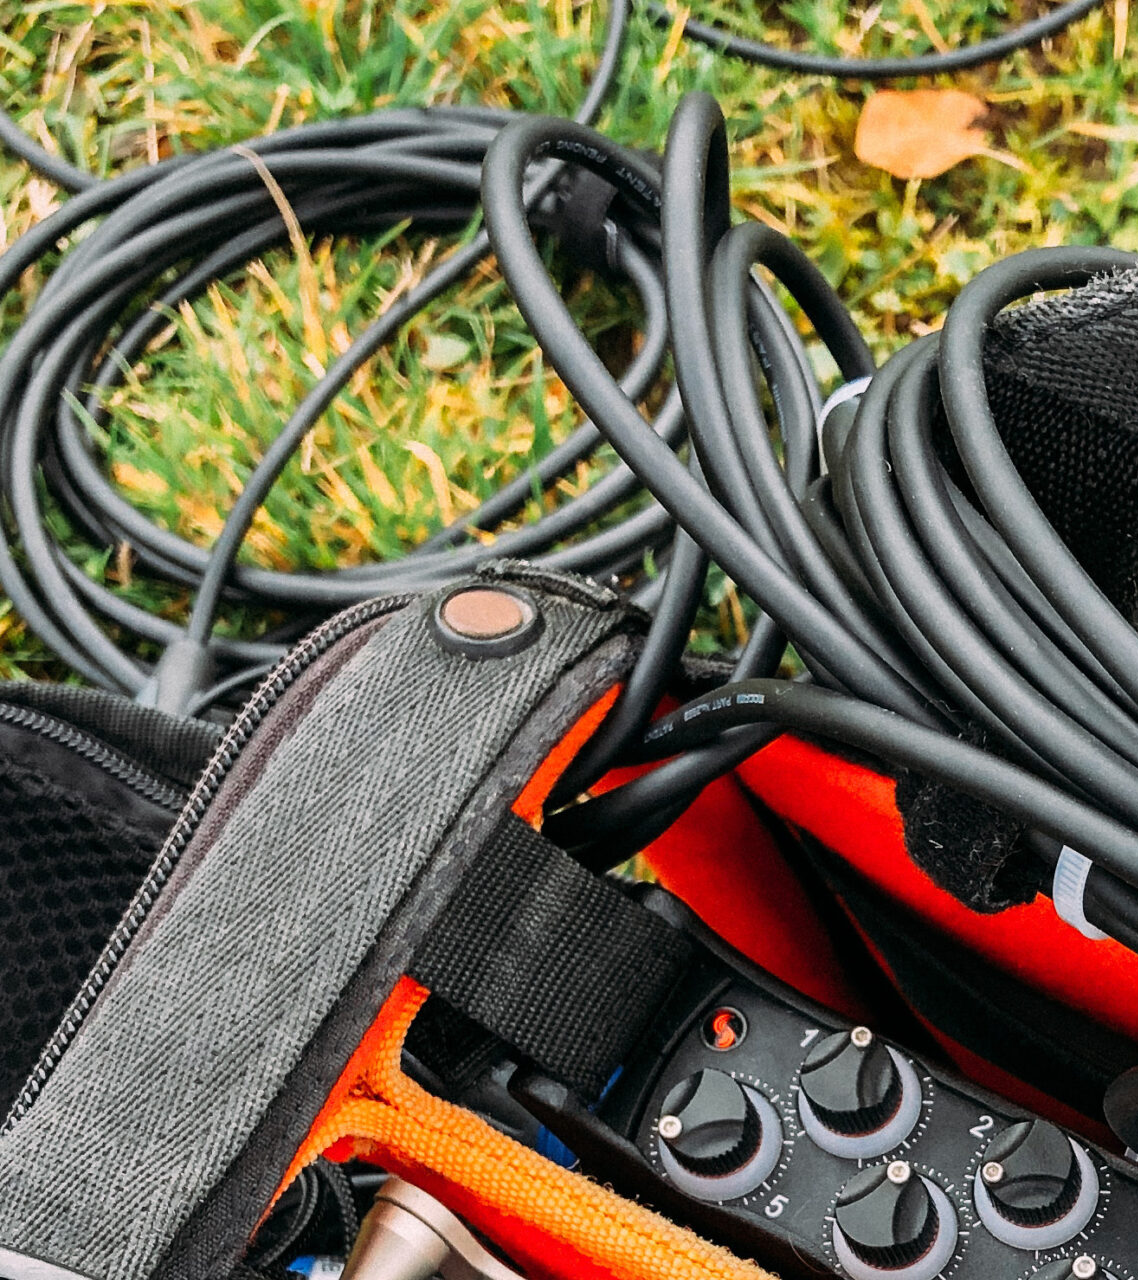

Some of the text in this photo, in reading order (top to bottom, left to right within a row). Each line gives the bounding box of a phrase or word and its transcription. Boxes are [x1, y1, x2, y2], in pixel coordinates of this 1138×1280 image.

[800, 1029, 820, 1048] 1
[969, 1115, 995, 1139] 2
[764, 1195, 790, 1219] 5
